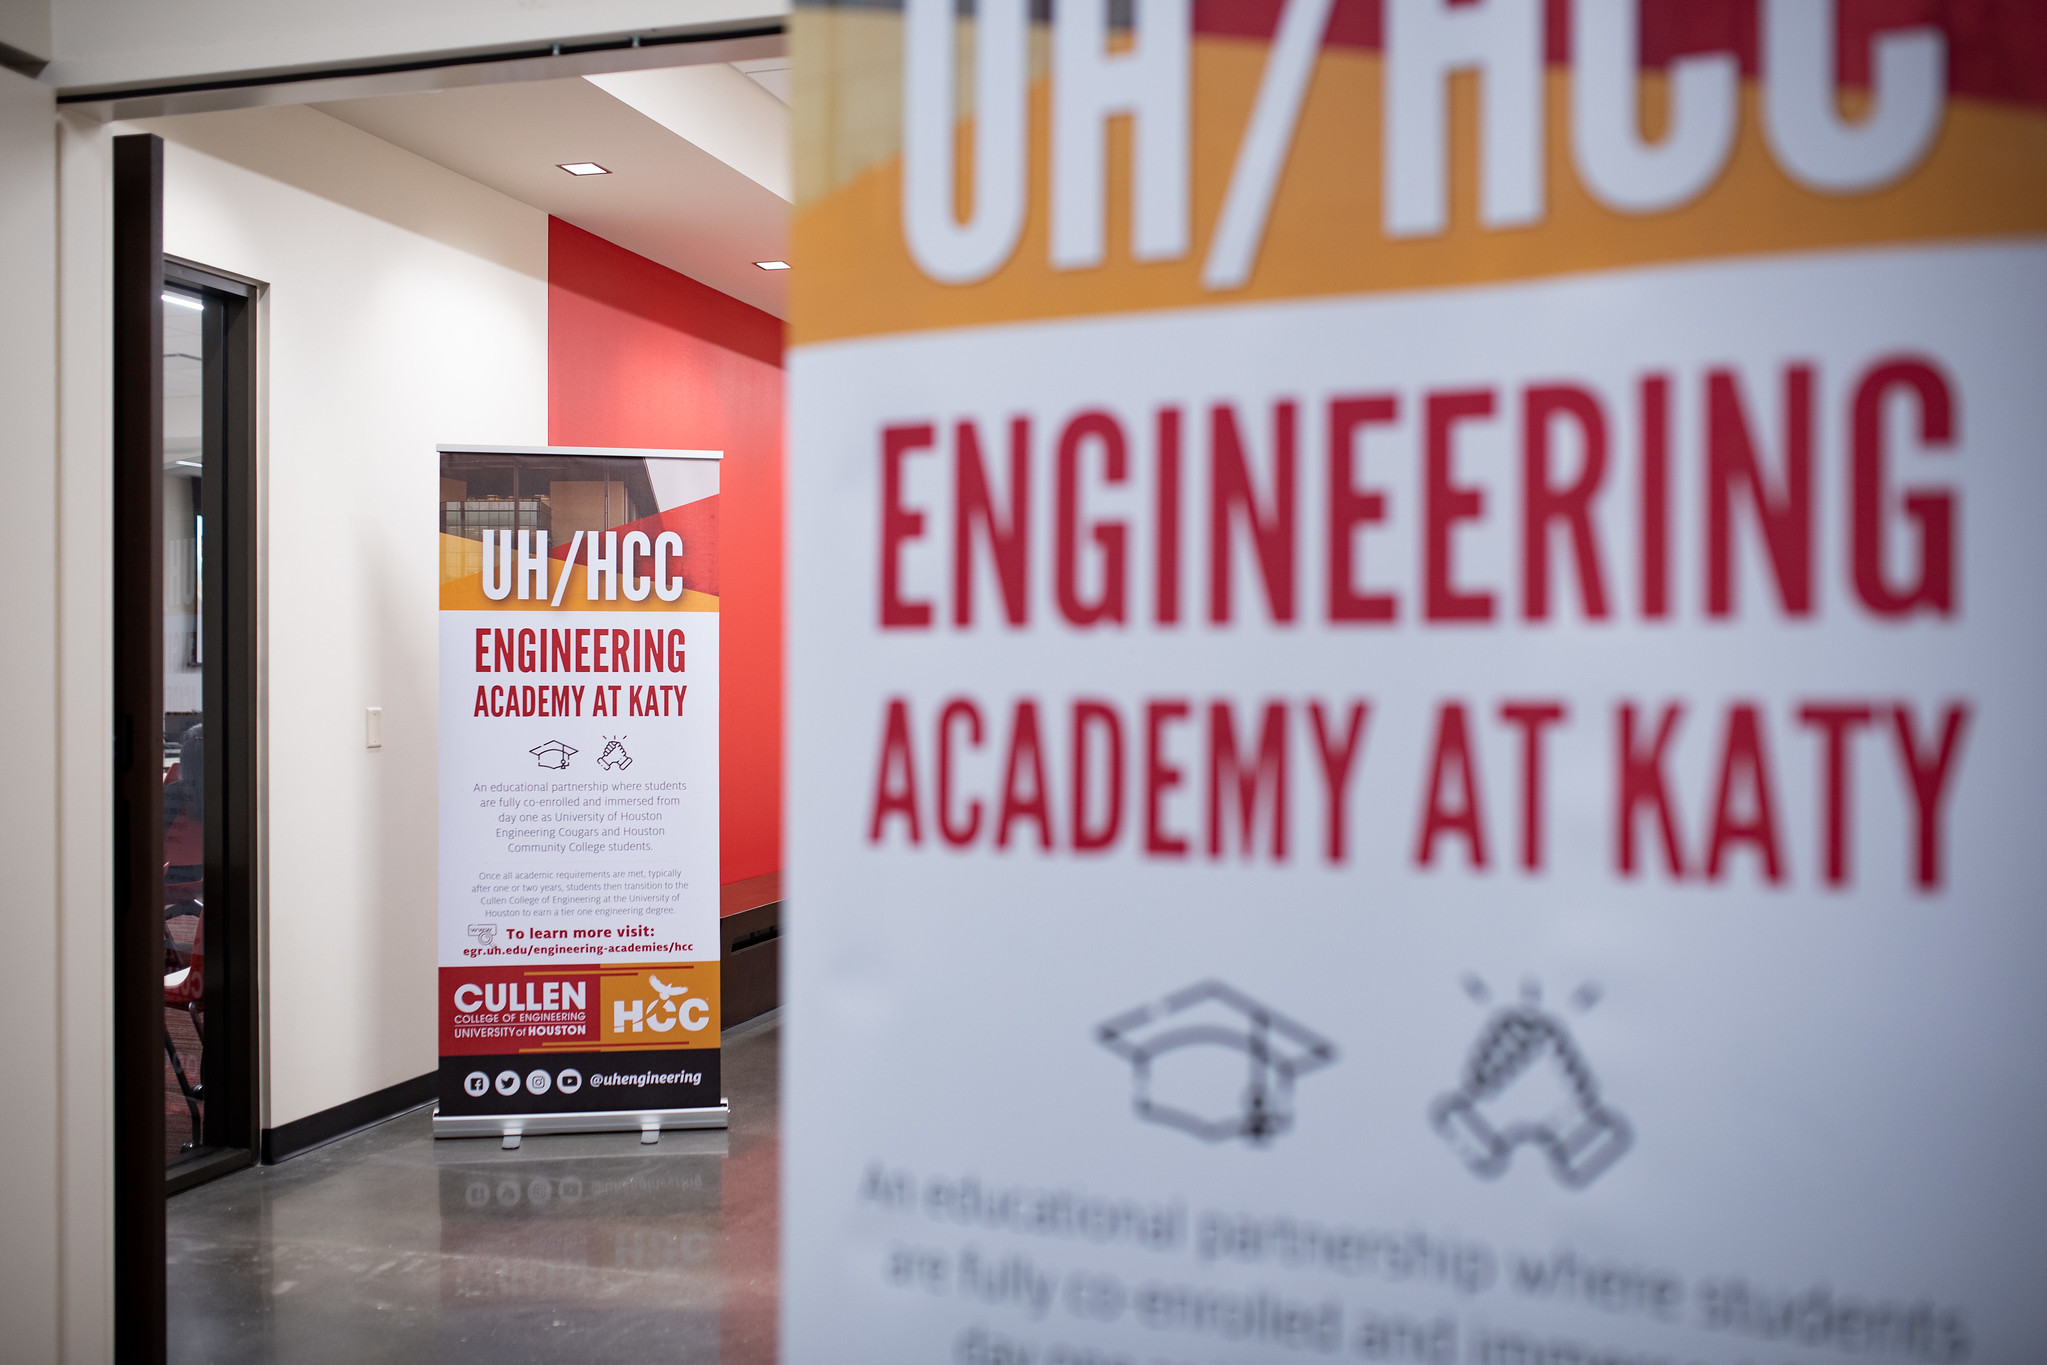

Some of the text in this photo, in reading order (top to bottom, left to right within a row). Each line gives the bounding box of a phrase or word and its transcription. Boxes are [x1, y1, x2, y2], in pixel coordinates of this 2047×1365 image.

[877, 352, 1961, 631] ENGINEERING
[482, 529, 683, 606] UH/HCC
[476, 628, 685, 673] ENGINEERING
[474, 685, 687, 717] ACADEMY AT KATY
[473, 780, 686, 793] An educational partnership where students
[480, 795, 679, 809] are fully co-enrolled and immersed from
[866, 698, 1976, 896] ACADEMY AT KATY
[499, 810, 662, 824] day one as University of Houston
[496, 826, 664, 839] Engineering Cougars and Houston
[508, 841, 653, 854] Community College students.
[479, 868, 681, 881] Once all academic requirements are met, typically
[472, 880, 688, 894] after one or two years, students then transition to the
[480, 892, 680, 906] Cullen College of Engineering at the University of
[485, 906, 675, 918] Houston to earn a tier one engineering degree.
[506, 925, 654, 939] To learn more visit:
[463, 942, 694, 957] egr.uh.edu/engineering-academies/hcc
[454, 981, 586, 1012] CULLEN
[454, 1011, 586, 1024] COLLEGE OF ENGINEERING
[613, 998, 710, 1033] HCC
[454, 1024, 586, 1038] UNIVERSITY of HOUSTON
[589, 1069, 702, 1088] @uhengineering
